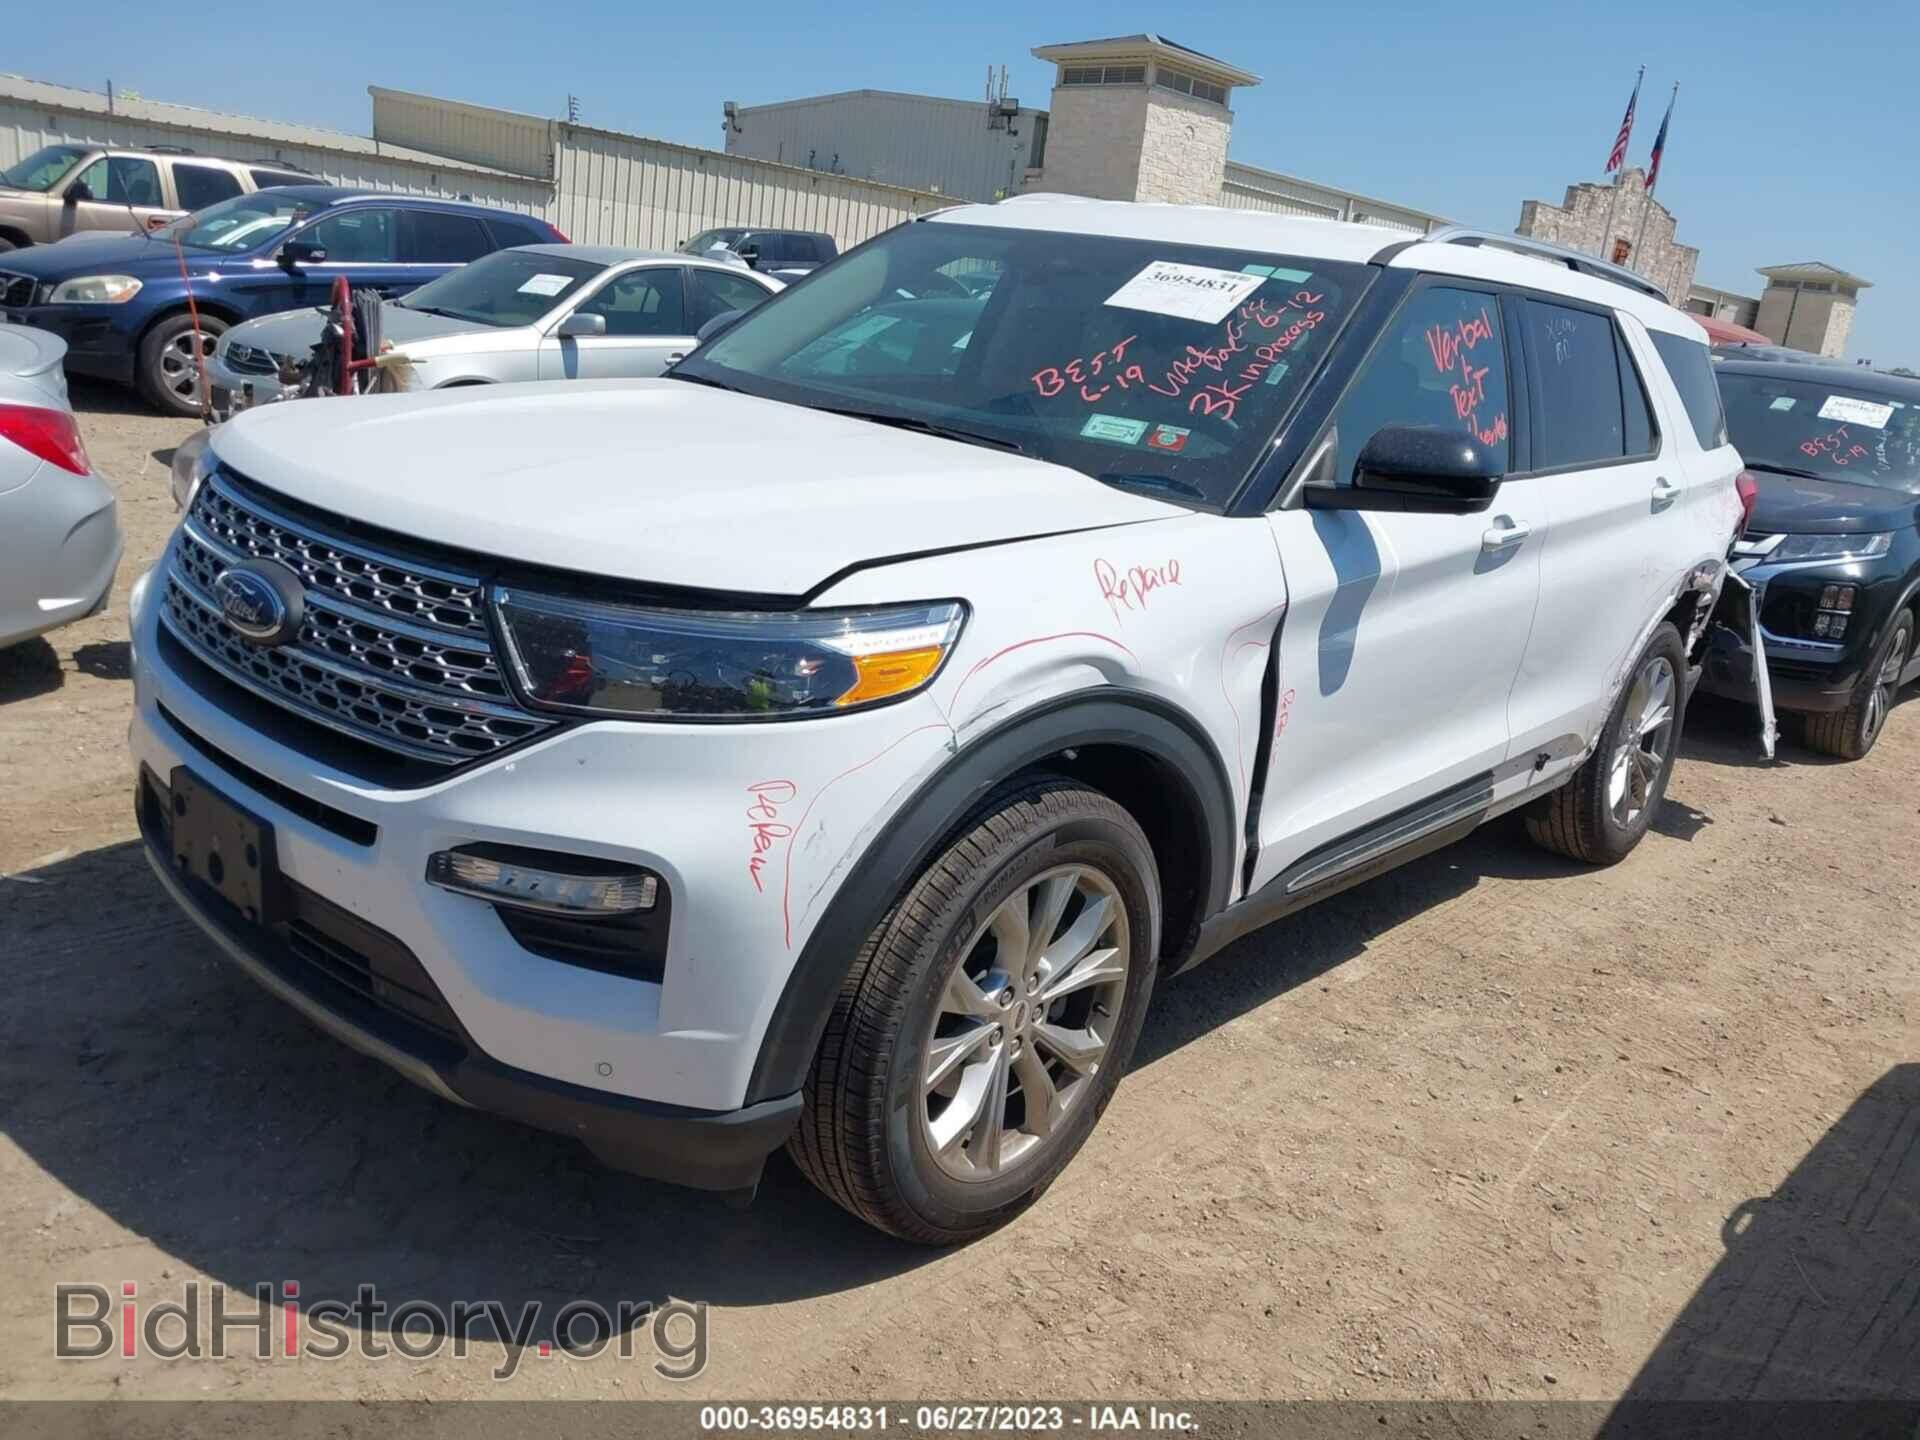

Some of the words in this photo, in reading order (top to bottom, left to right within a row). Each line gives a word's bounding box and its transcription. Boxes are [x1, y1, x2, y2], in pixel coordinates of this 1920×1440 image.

[1147, 271, 1237, 292] 36954831
[1031, 335, 1138, 397] BEST
[1425, 306, 1494, 373] Verbal
